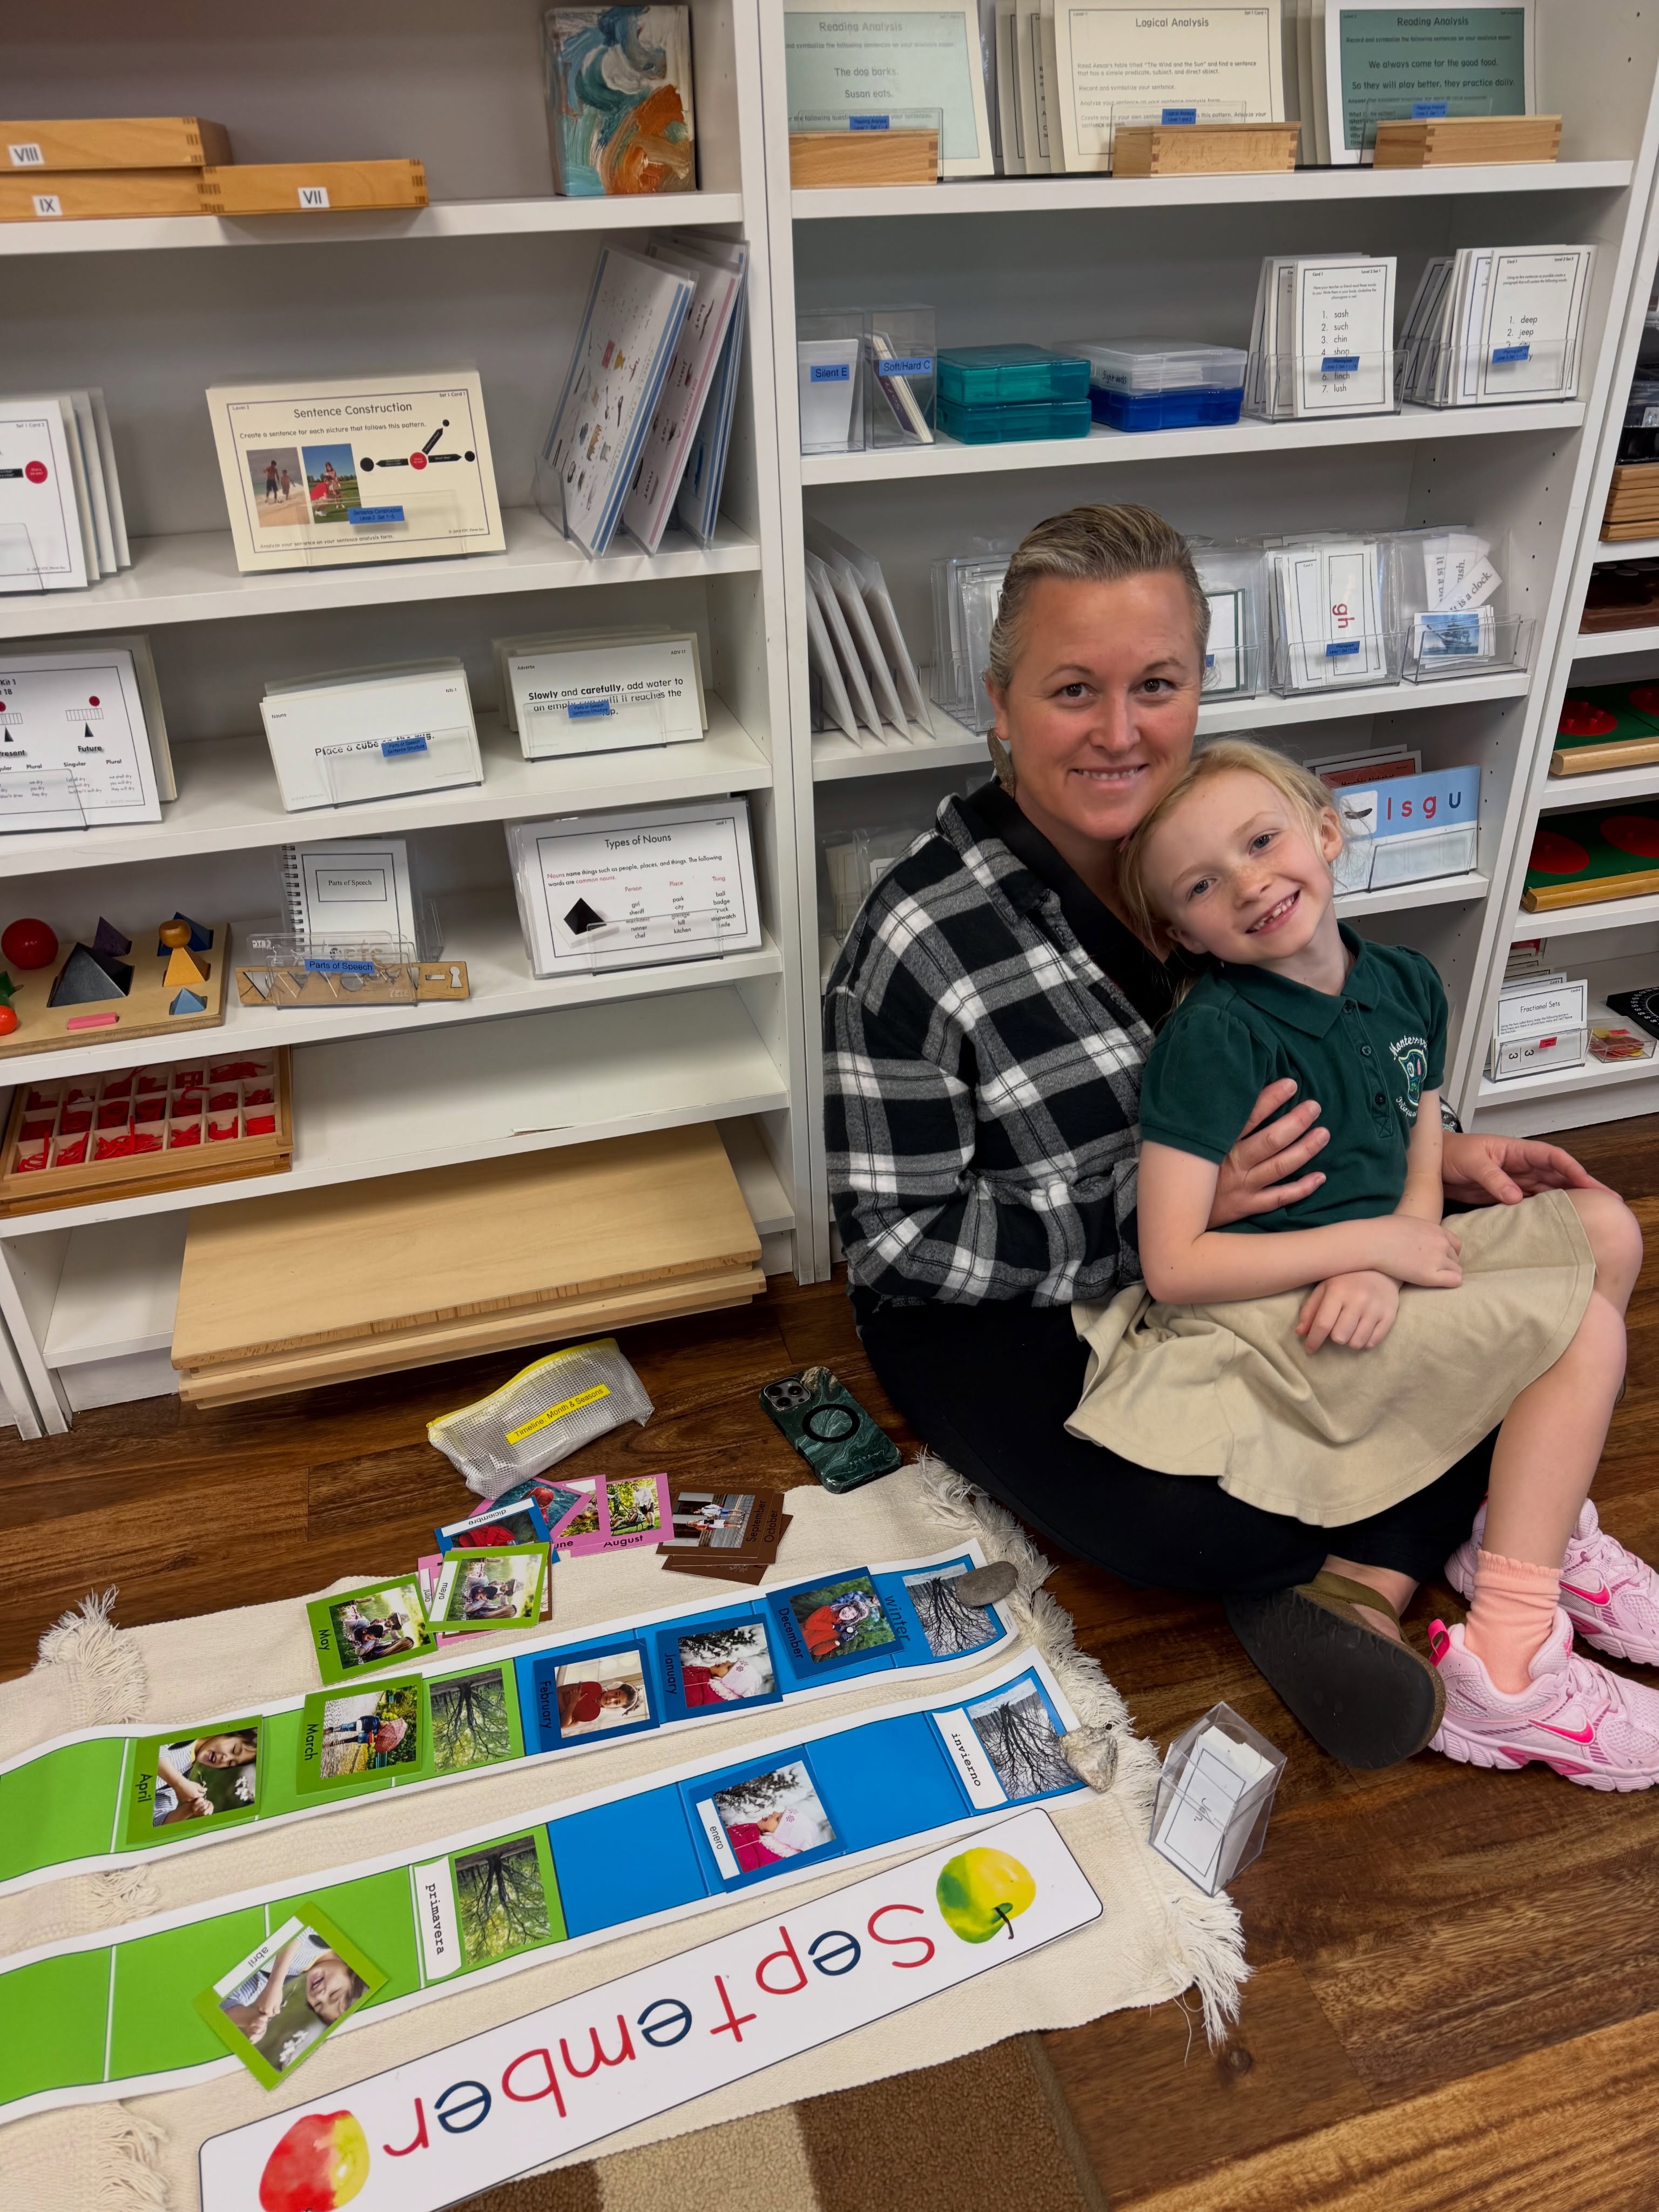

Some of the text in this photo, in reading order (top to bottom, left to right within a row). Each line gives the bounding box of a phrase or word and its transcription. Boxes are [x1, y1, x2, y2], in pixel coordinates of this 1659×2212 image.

[820, 22, 902, 31] Reading Analysis
[1136, 17, 1209, 28] Logical Analysis
[1397, 16, 1468, 26] Reading Analysis
[1383, 60, 1409, 69] always
[1447, 59, 1458, 67] the
[1461, 58, 1478, 67] good
[834, 67, 899, 76] The dog barks.
[1352, 82, 1361, 90] So
[1364, 82, 1379, 90] they
[1399, 81, 1414, 89] play
[1444, 80, 1460, 88] they
[1463, 79, 1493, 87] practice
[845, 90, 893, 98] Susan eats.
[14, 147, 38, 162] VIII
[303, 191, 321, 205] VII
[39, 199, 54, 213] IX
[1323, 309, 1348, 319] 1. sash
[1521, 315, 1537, 325] deep
[1334, 322, 1348, 331] such
[1518, 329, 1534, 339] jeep
[1334, 335, 1347, 343] chin
[815, 368, 847, 377] Silent E
[884, 361, 930, 372] Soft/Hard C
[1334, 372, 1350, 380] finch
[1323, 385, 1328, 393] 7.
[294, 402, 412, 418] Sentence Construction
[1458, 599, 1466, 608] is
[1472, 572, 1492, 594] clock.
[1333, 603, 1355, 629] gh
[529, 691, 557, 700] Slowly
[562, 688, 577, 697] and
[581, 684, 624, 695] carefully,
[627, 682, 643, 690] add
[646, 678, 671, 687] water
[315, 747, 343, 756] Place
[356, 741, 378, 750] cube
[605, 835, 671, 849] Types of Nouns
[309, 961, 372, 971] Parts of Speech
[1521, 1002, 1547, 1013] Fractional
[514, 1418, 547, 1437] Timeline:
[547, 1404, 569, 1419] Month
[575, 1389, 603, 1404] Seasons
[469, 1509, 506, 1526] diciembre
[746, 1500, 766, 1542] September
[764, 1509, 778, 1542] October
[603, 1535, 643, 1548] August
[438, 1582, 448, 1600] mayo
[884, 1595, 911, 1642] winter
[318, 1628, 330, 1651] May
[778, 1608, 804, 1659] December
[664, 1653, 677, 1695] January
[539, 1680, 552, 1729] February
[304, 1723, 319, 1761] March
[951, 1732, 981, 1788] invierno
[137, 1773, 152, 1803] April
[709, 1825, 724, 1850] enero
[426, 1883, 444, 1954] primavera
[247, 1946, 268, 1968] abril
[383, 1903, 935, 2158] September
